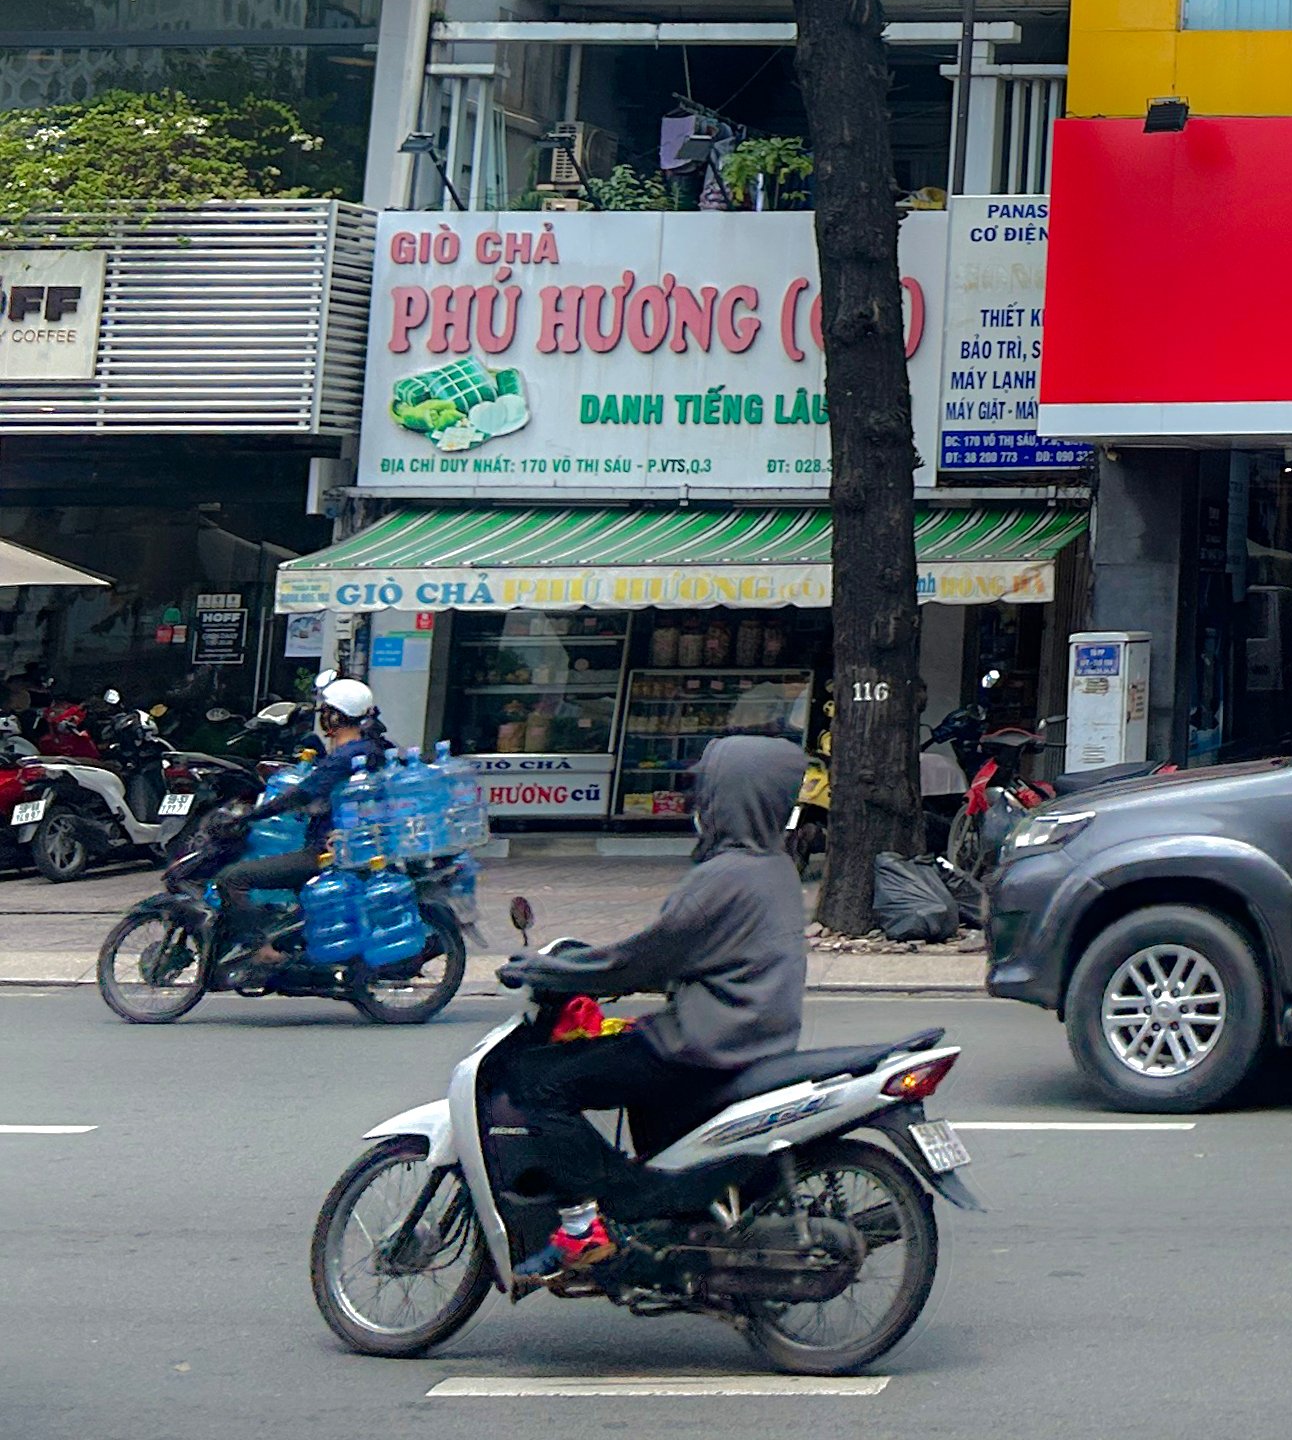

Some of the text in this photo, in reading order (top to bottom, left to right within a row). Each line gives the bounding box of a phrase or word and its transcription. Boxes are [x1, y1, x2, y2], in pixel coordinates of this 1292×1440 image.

[390, 221, 559, 264] GIÒ CHẢ
[970, 225, 998, 242] CƠ
[388, 267, 522, 353] PHÚ
[536, 270, 761, 354] HƯƠNG
[980, 301, 1045, 327] THIẾT K
[12, 329, 77, 343] COFFEE
[960, 334, 992, 359] BẢO
[997, 335, 1027, 362] TRÌ,
[951, 366, 1036, 393] MÁY LẠNH
[580, 394, 664, 425] DANH
[675, 386, 763, 425] TIẾNG
[946, 397, 974, 420] MÁY
[978, 398, 1006, 424] GIẶT
[381, 458, 405, 475] ĐỊA
[410, 454, 434, 473] CHỈ
[440, 458, 467, 473] DUY
[473, 454, 515, 473] NHẤT:
[521, 458, 546, 473] 170
[552, 455, 571, 473] VÕ
[577, 458, 599, 476] THỊ
[604, 455, 631, 473] SÁU
[767, 459, 789, 473] ĐT:
[336, 577, 403, 606] GIÒ
[416, 572, 495, 605] CHẢ
[202, 613, 241, 623] HOFF
[853, 682, 889, 701] 116
[490, 783, 568, 804] HƯƠNG
[571, 783, 600, 801] cũ
